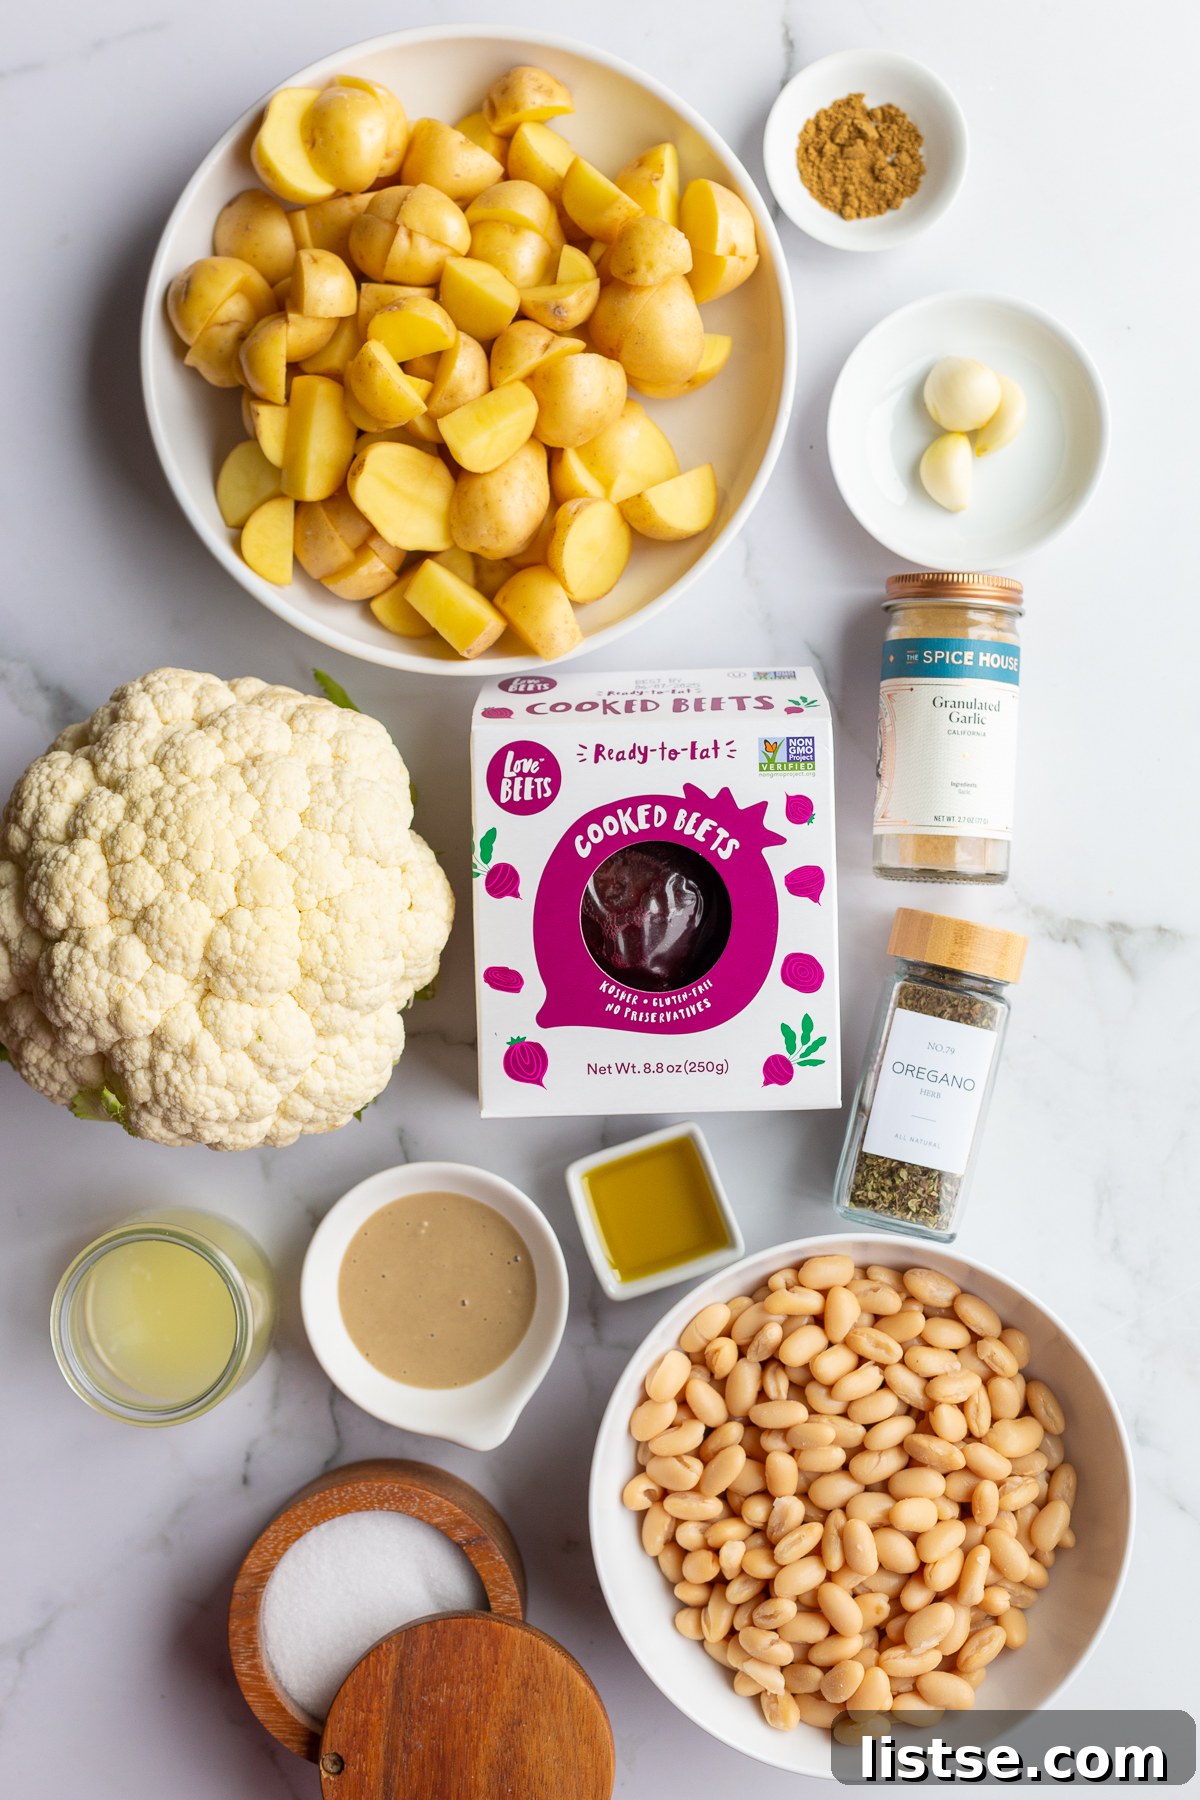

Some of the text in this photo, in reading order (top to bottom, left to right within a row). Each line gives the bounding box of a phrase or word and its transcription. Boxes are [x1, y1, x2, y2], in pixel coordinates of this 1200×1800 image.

[923, 650, 974, 666] SPICE
[978, 652, 1019, 672] HOUSE
[508, 683, 550, 692] BEETS
[607, 688, 691, 696] Ready-to-Eat
[525, 695, 775, 716] COOKED BEETS
[932, 696, 1000, 712] Granulated
[948, 711, 987, 725] Garlic
[947, 729, 986, 737] CALIFORNIA
[789, 738, 813, 747] NON
[593, 739, 720, 765] Ready-to-Eat
[788, 746, 813, 759] GMO
[789, 754, 813, 762] Project
[761, 763, 814, 771] VERIFIED
[500, 776, 552, 804] BEETS
[574, 804, 740, 860] COOKED BEETS
[599, 978, 713, 1008] KOSHER GLUTEN-FREE
[605, 998, 712, 1023] NO PRESERVATIVES
[927, 1041, 955, 1055] NO.79
[587, 1058, 729, 1075] Net Wt. 8.8 oz (250g)
[891, 1061, 976, 1092] OREGANO
[919, 1087, 941, 1099] HERB
[894, 1132, 941, 1149] ALL NATURAL
